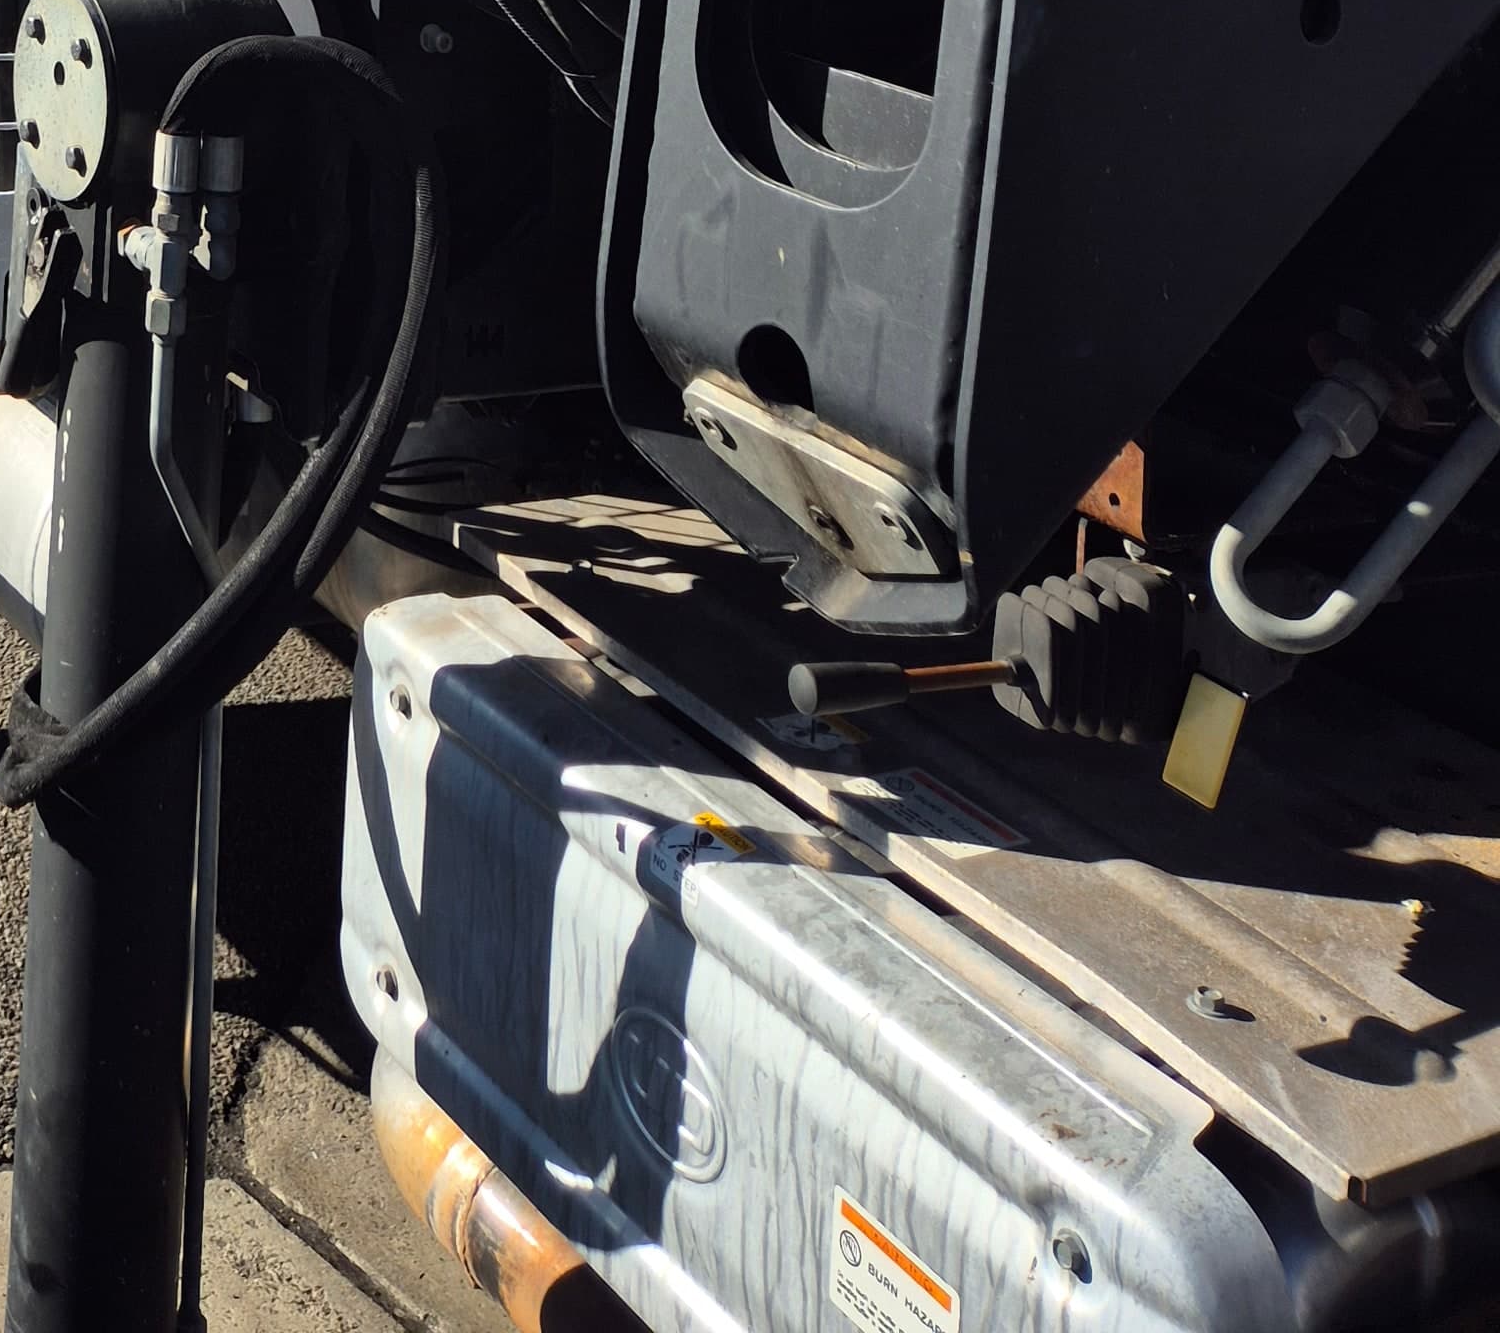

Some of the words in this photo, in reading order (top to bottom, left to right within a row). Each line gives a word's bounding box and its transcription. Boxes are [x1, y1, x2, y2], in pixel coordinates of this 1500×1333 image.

[653, 854, 668, 871] NO
[867, 1262, 899, 1298] BURN
[904, 1295, 946, 1333] HAZAR
